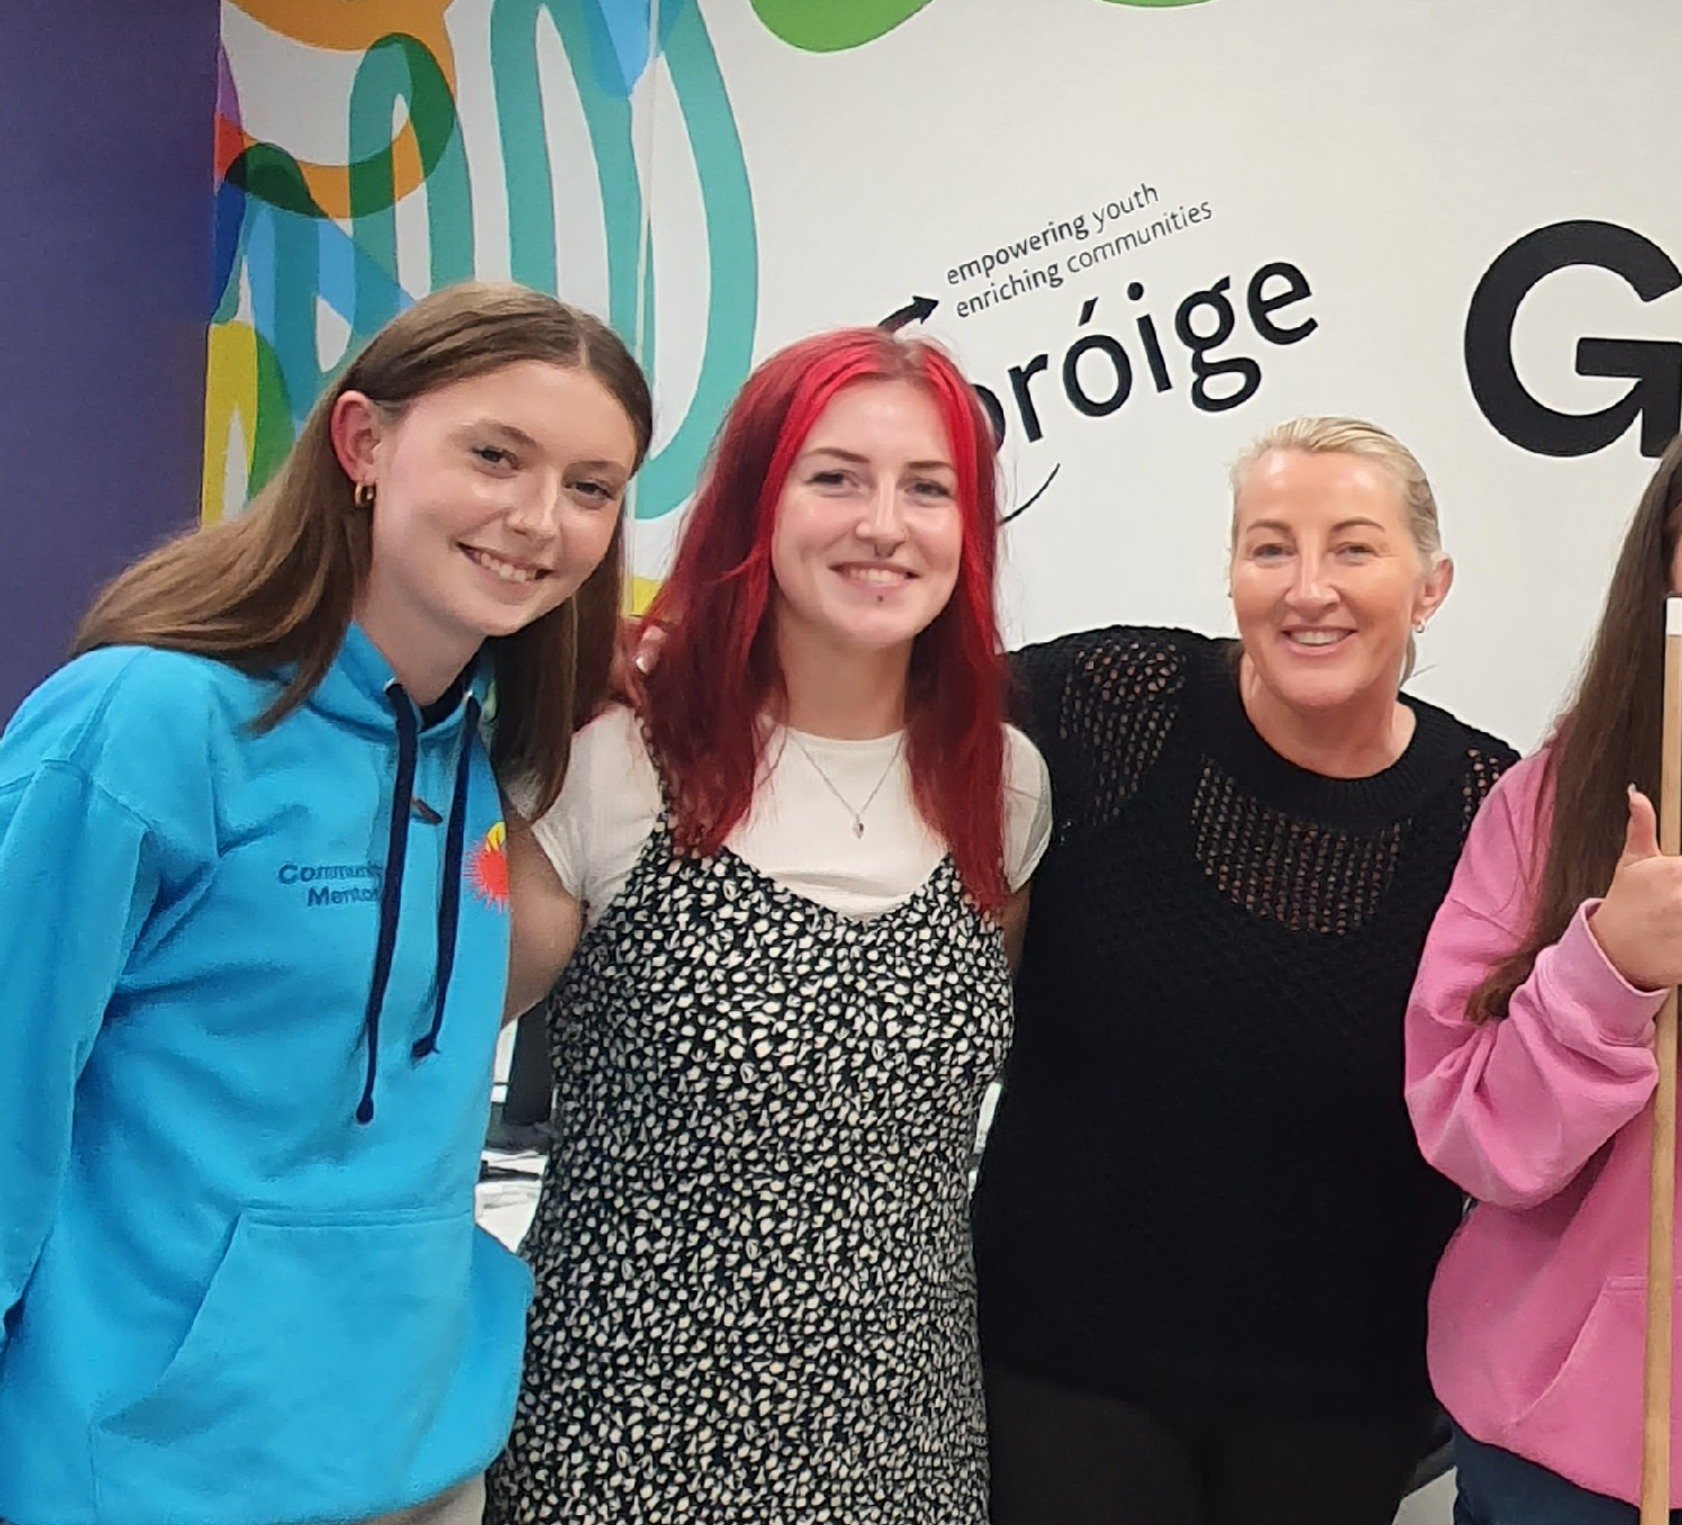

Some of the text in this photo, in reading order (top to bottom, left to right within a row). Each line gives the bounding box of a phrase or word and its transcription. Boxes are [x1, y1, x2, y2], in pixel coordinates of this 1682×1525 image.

[946, 182, 1159, 287] empowering youth
[955, 199, 1214, 318] enriching communities
